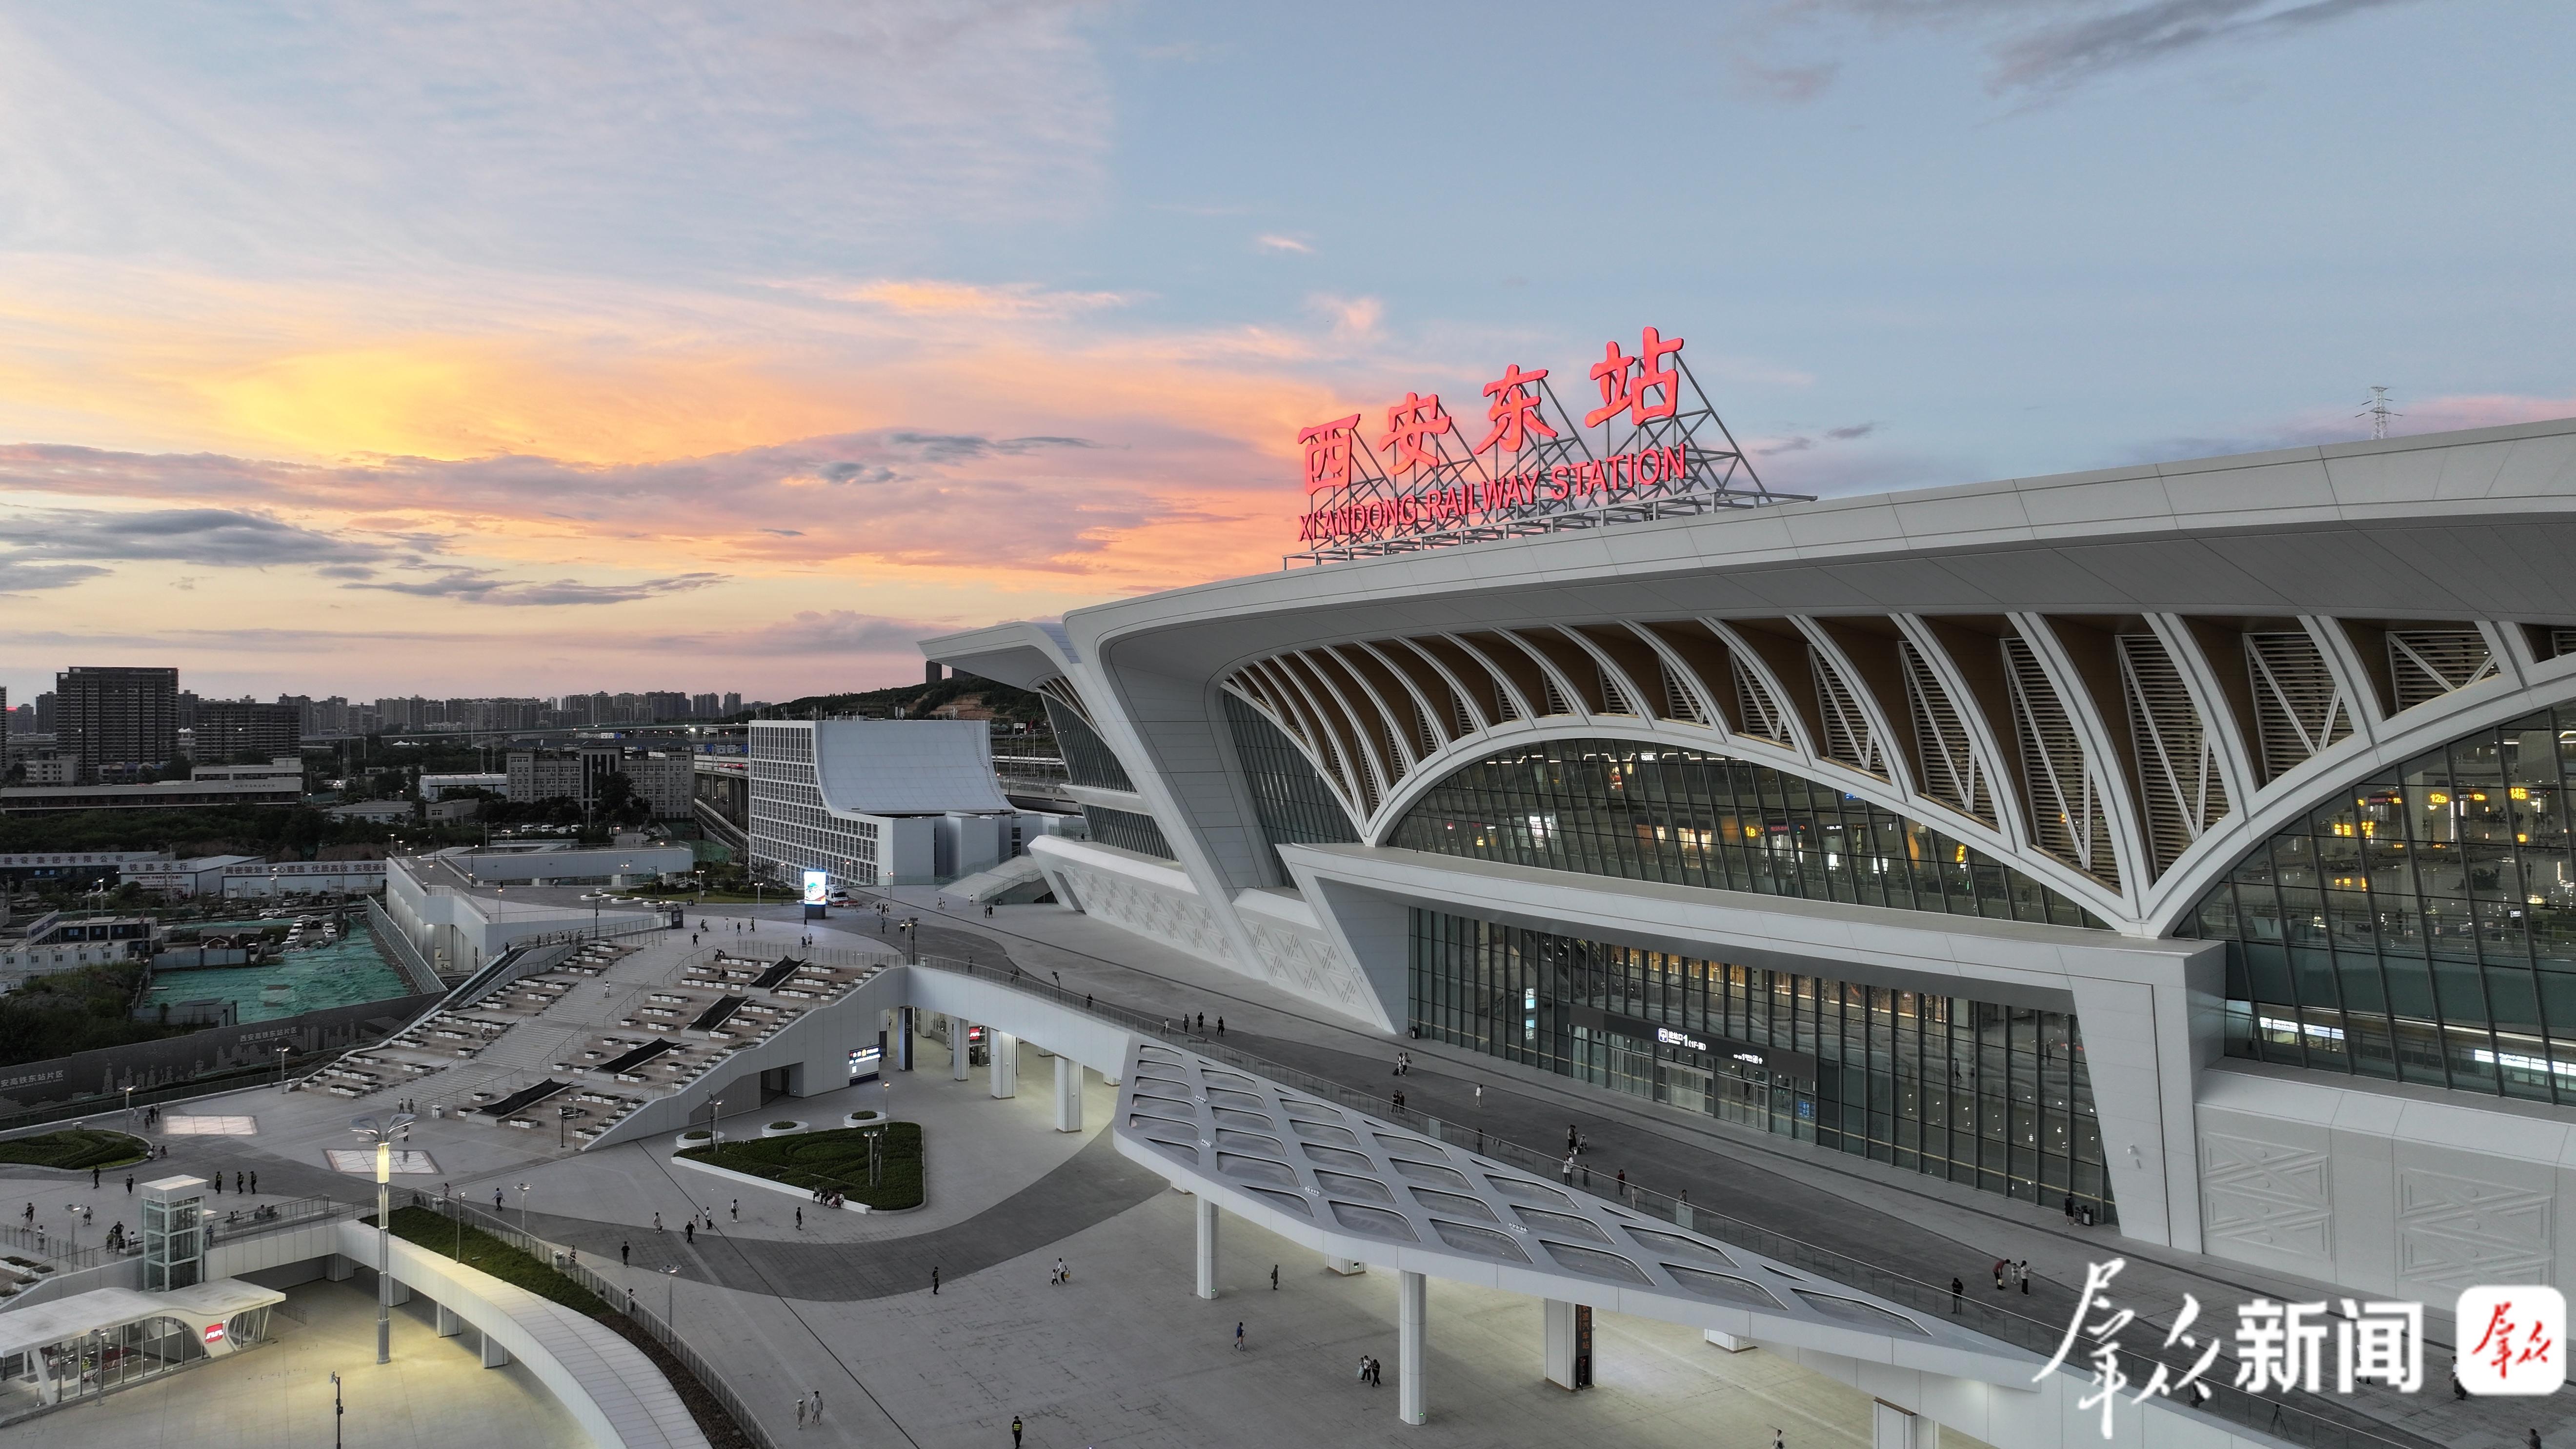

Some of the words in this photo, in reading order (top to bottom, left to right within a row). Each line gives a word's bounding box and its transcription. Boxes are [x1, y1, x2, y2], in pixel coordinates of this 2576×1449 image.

[1297, 326, 1684, 496] 西安东站
[1298, 494, 1418, 542] XI'ANDONG
[1426, 470, 1541, 521] RAILWAY
[1550, 443, 1687, 501] STATION
[4, 855, 124, 865] 建设集团有限公司
[128, 863, 188, 872] 铁路先行
[225, 865, 262, 874] 周密策划
[311, 864, 348, 873] 优质高效
[240, 1026, 298, 1043] 西安高铁东站片区
[1683, 1034, 1688, 1047] 1
[0, 1070, 64, 1087] 安高铁东站片区
